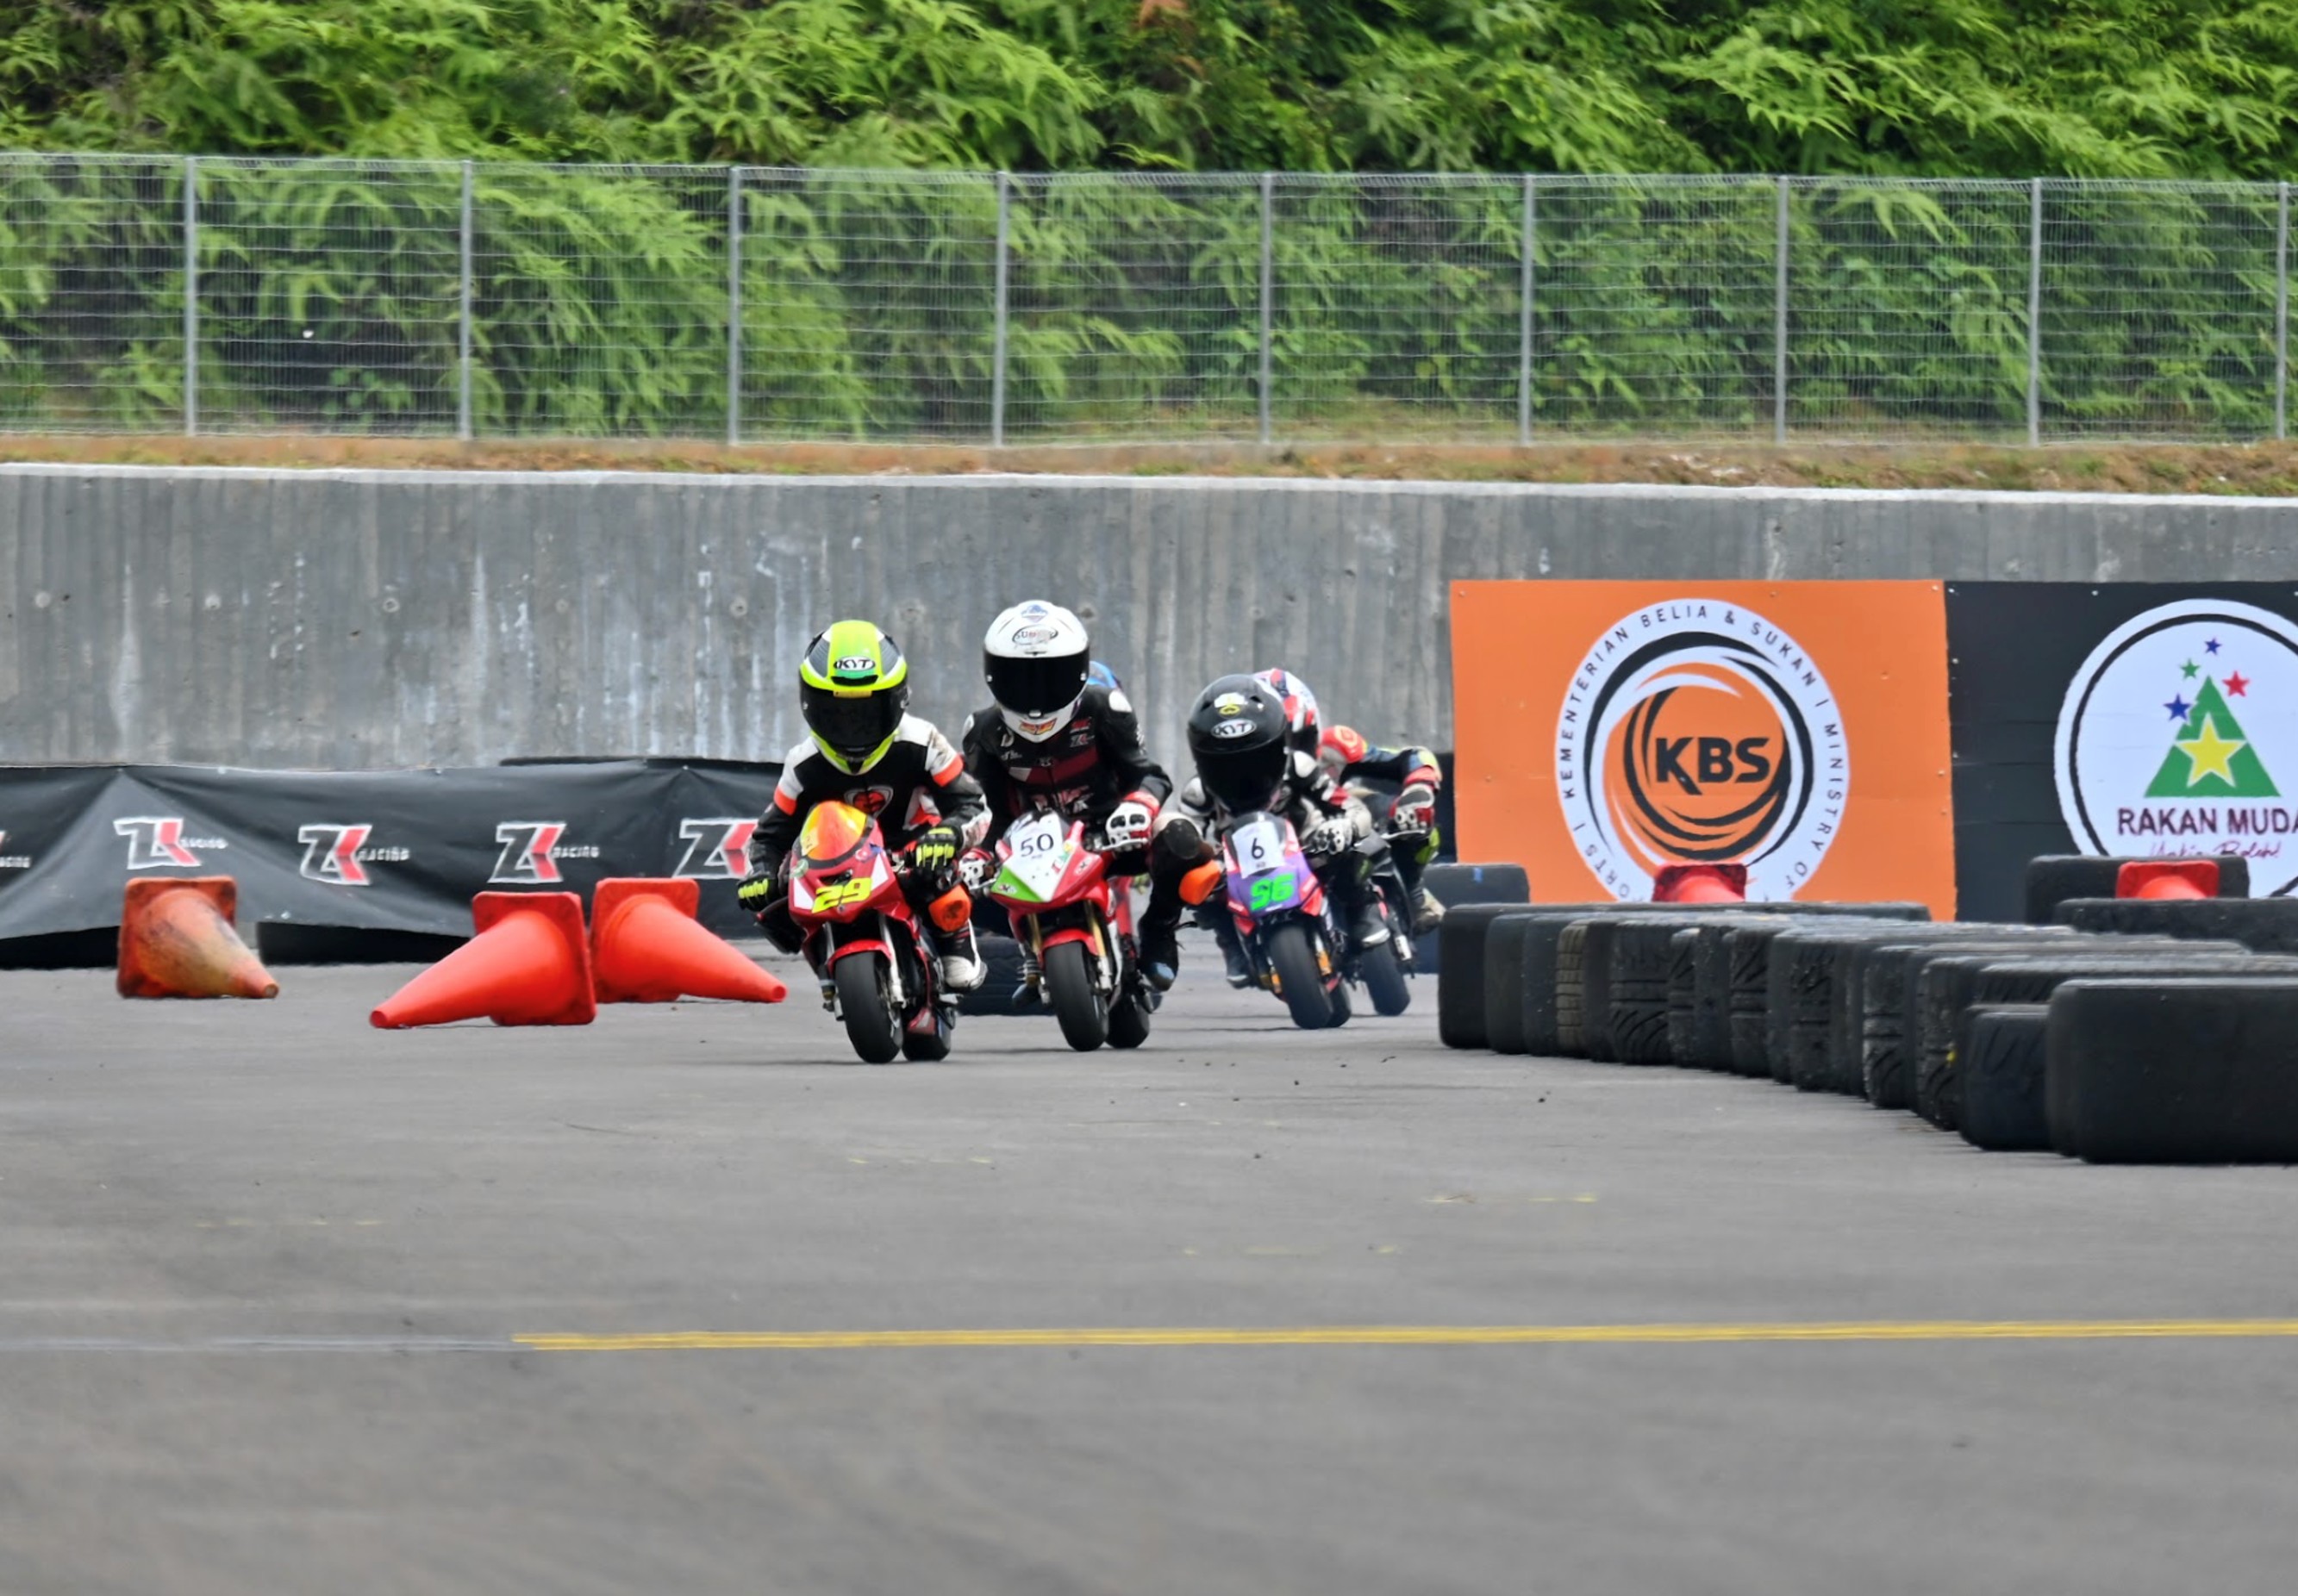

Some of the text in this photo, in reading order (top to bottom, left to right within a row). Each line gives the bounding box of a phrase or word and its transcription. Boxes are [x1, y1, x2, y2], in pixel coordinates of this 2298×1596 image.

[838, 658, 871, 669] KYT
[1559, 627, 1630, 800] KEMENTERIAN
[1641, 605, 1708, 628] BELIA
[1724, 610, 1736, 625] &
[1751, 621, 1818, 688] SUKAN
[1811, 722, 1844, 851] MINISTRY
[1654, 737, 1770, 795] KBS
[2117, 807, 2218, 836] RAKAN
[1020, 832, 1054, 857] 50
[1251, 837, 1265, 859] 6
[1584, 843, 1644, 901] ORTS
[812, 877, 872, 913] 29
